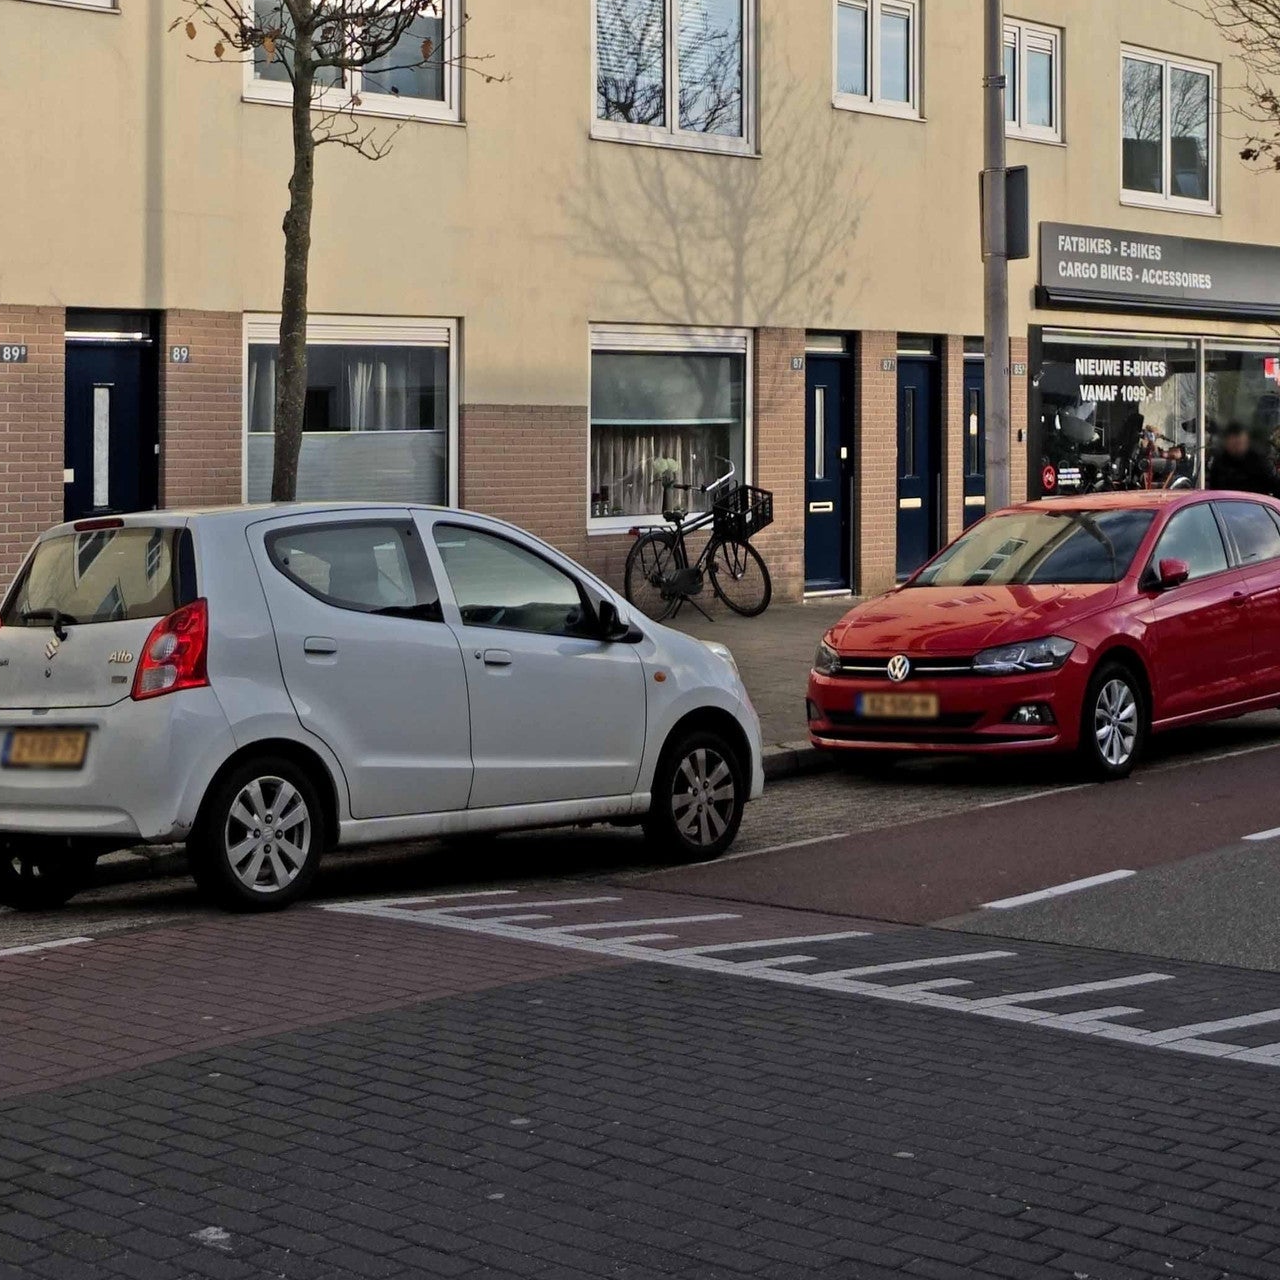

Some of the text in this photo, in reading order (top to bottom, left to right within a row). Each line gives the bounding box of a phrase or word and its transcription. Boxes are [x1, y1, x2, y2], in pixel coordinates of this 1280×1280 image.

[1058, 235, 1112, 255] FATBIKES
[1120, 241, 1162, 260] E-BIKES
[1058, 261, 1098, 279] CARGO
[1100, 264, 1133, 282] BIKES
[1141, 268, 1212, 289] ACCESSOIRES
[172, 346, 189, 361] 89
[793, 358, 803, 369] 87
[1075, 358, 1166, 378] NIEUWE E-BIKES
[1080, 385, 1118, 402] VANAF
[108, 650, 133, 664] Alto
